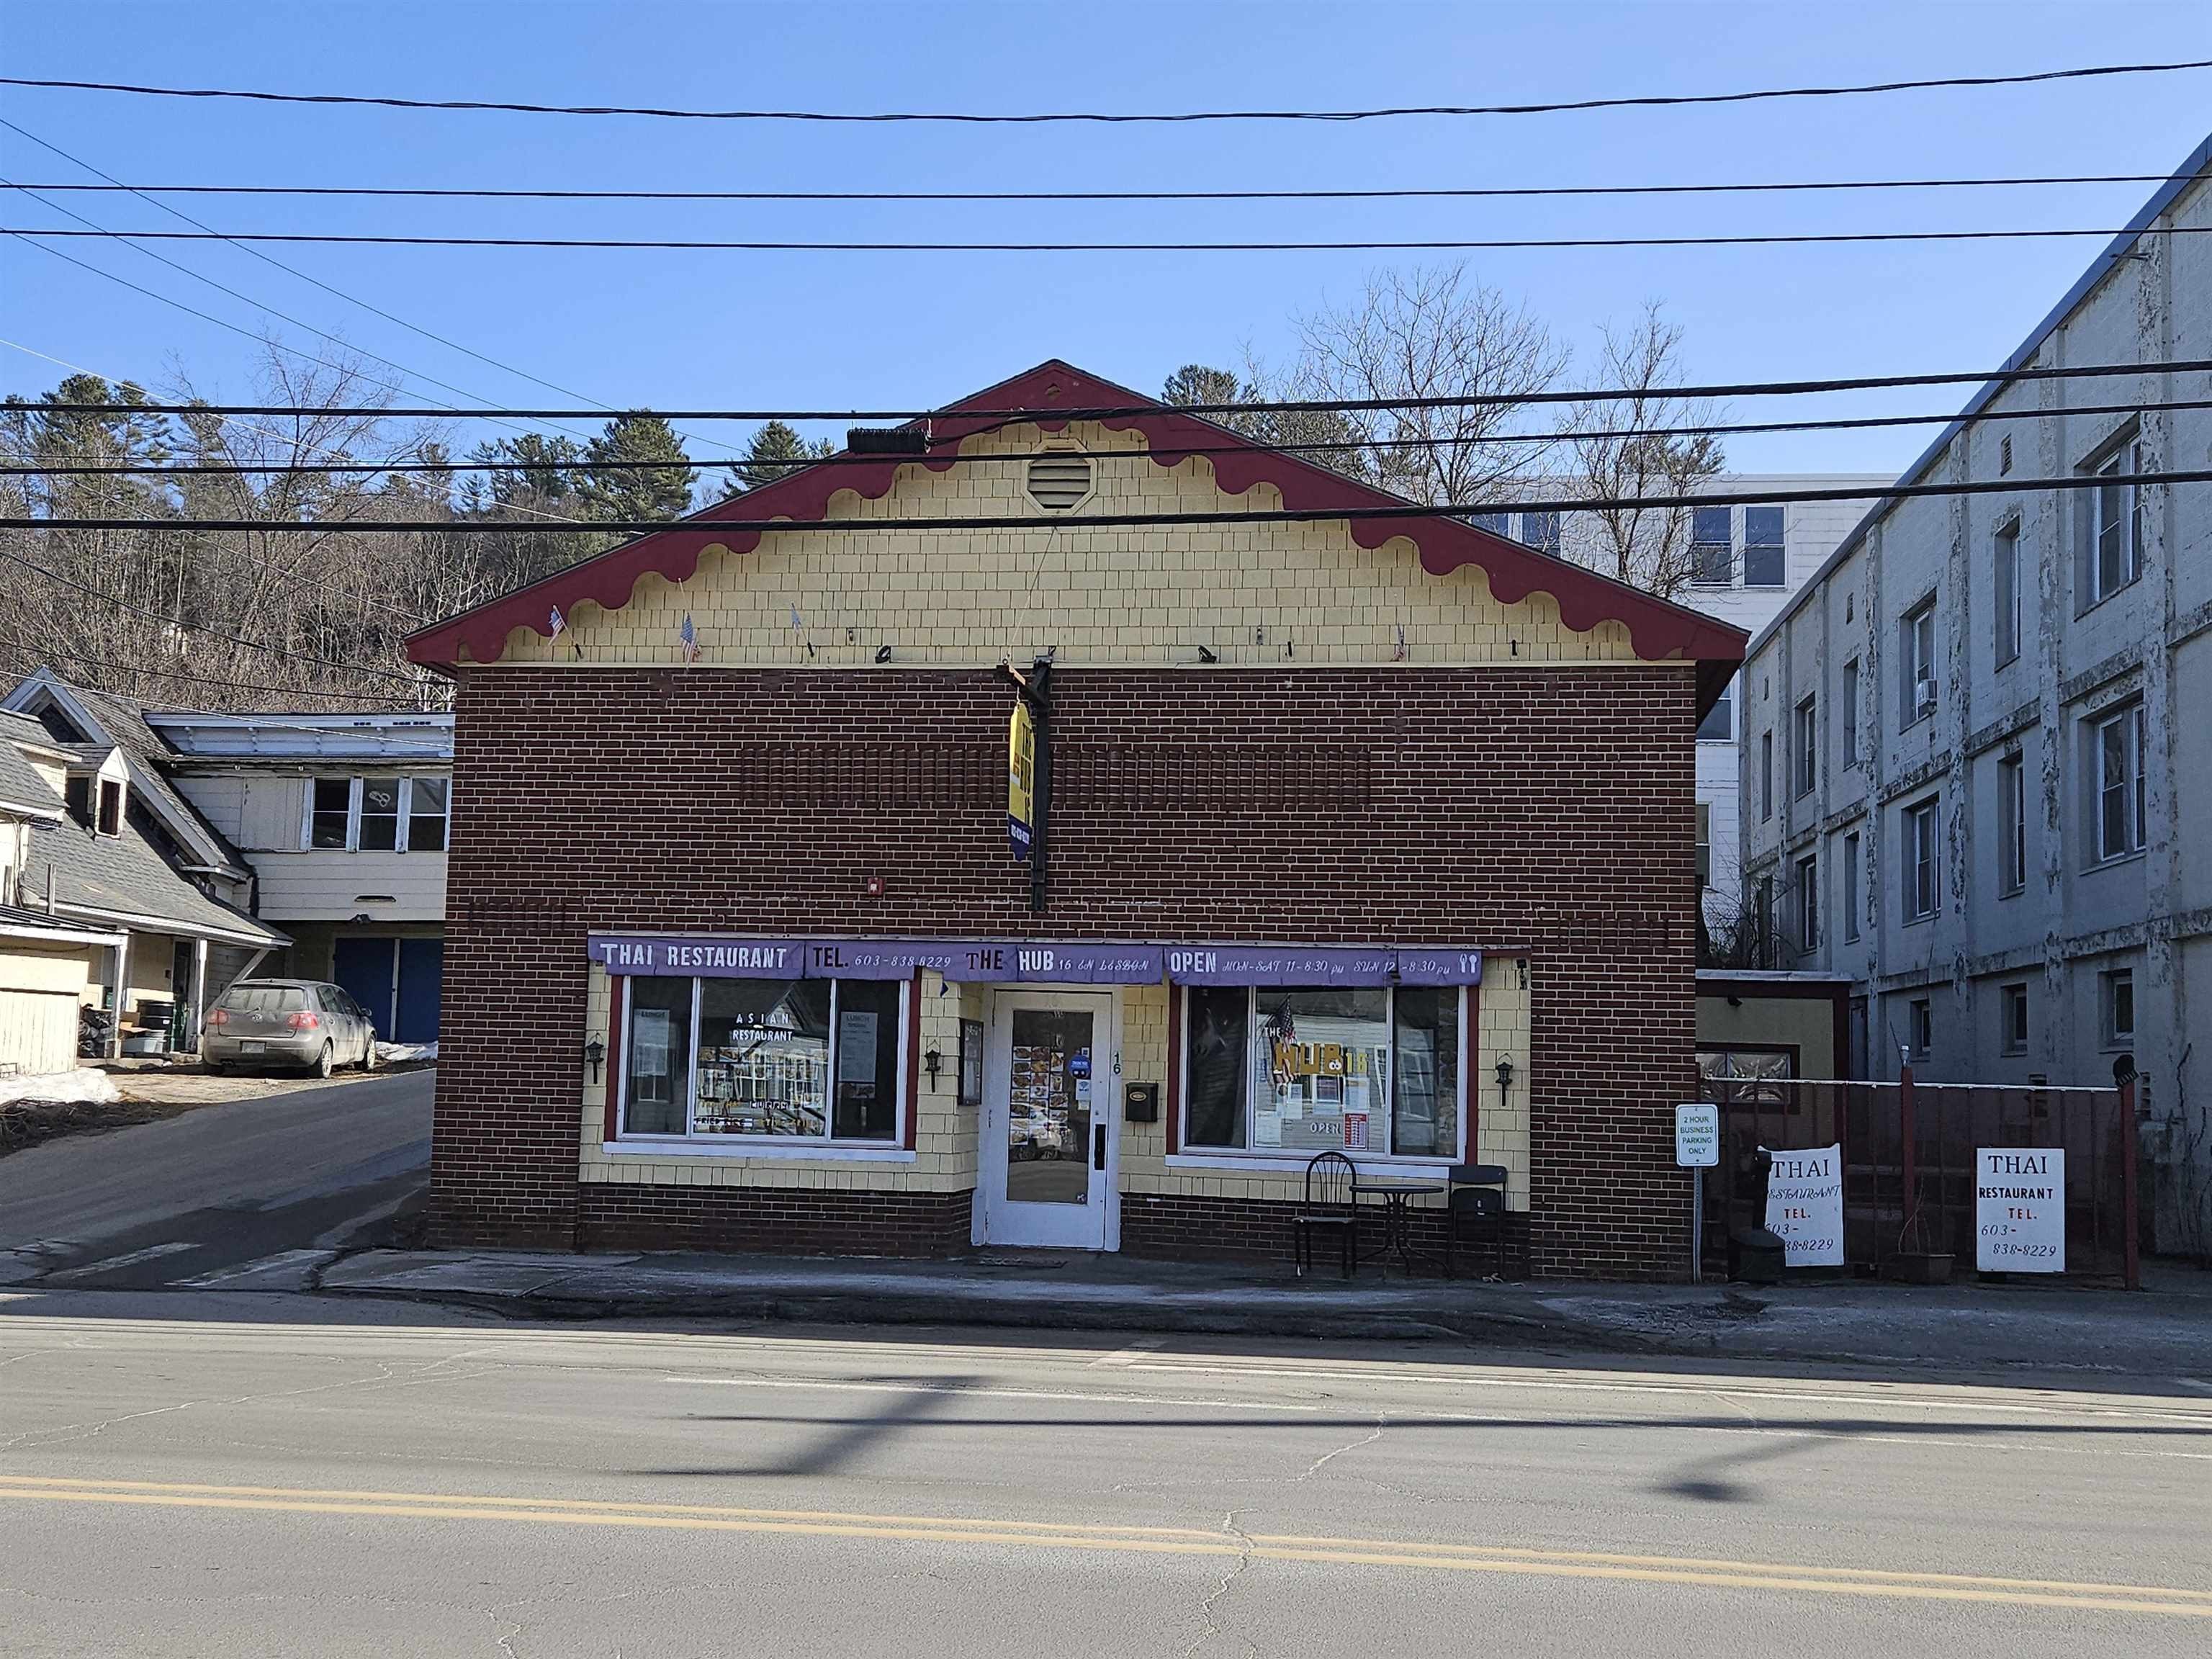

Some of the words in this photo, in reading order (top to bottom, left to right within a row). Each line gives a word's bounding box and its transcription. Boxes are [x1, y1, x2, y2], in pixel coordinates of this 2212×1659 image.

[600, 943, 652, 965] THAI
[667, 946, 786, 968] RESTAURANT
[813, 947, 849, 968] TEL.
[966, 950, 1004, 969] THE
[1019, 950, 1053, 971] HUB
[1059, 959, 1071, 970] 16
[1170, 952, 1216, 973] OPEN
[736, 1012, 788, 1024] ASIAN
[732, 1030, 793, 1041] RESTAURANT
[1264, 1027, 1281, 1038] THE
[1274, 1043, 1343, 1074] HUB
[1310, 1123, 1341, 1135] OPEN
[1773, 1159, 1830, 1179] THAI
[1989, 1155, 2048, 1174] THAI
[1768, 1184, 1840, 1200] ESTAURANT
[1979, 1187, 2054, 1199] RESTAURANT
[1784, 1208, 1811, 1219] TEL.
[2008, 1208, 2038, 1220] TEL.
[1982, 1224, 2016, 1236] 603-
[1786, 1238, 1833, 1251] 38-8229
[1992, 1243, 2056, 1256] 838-8229
